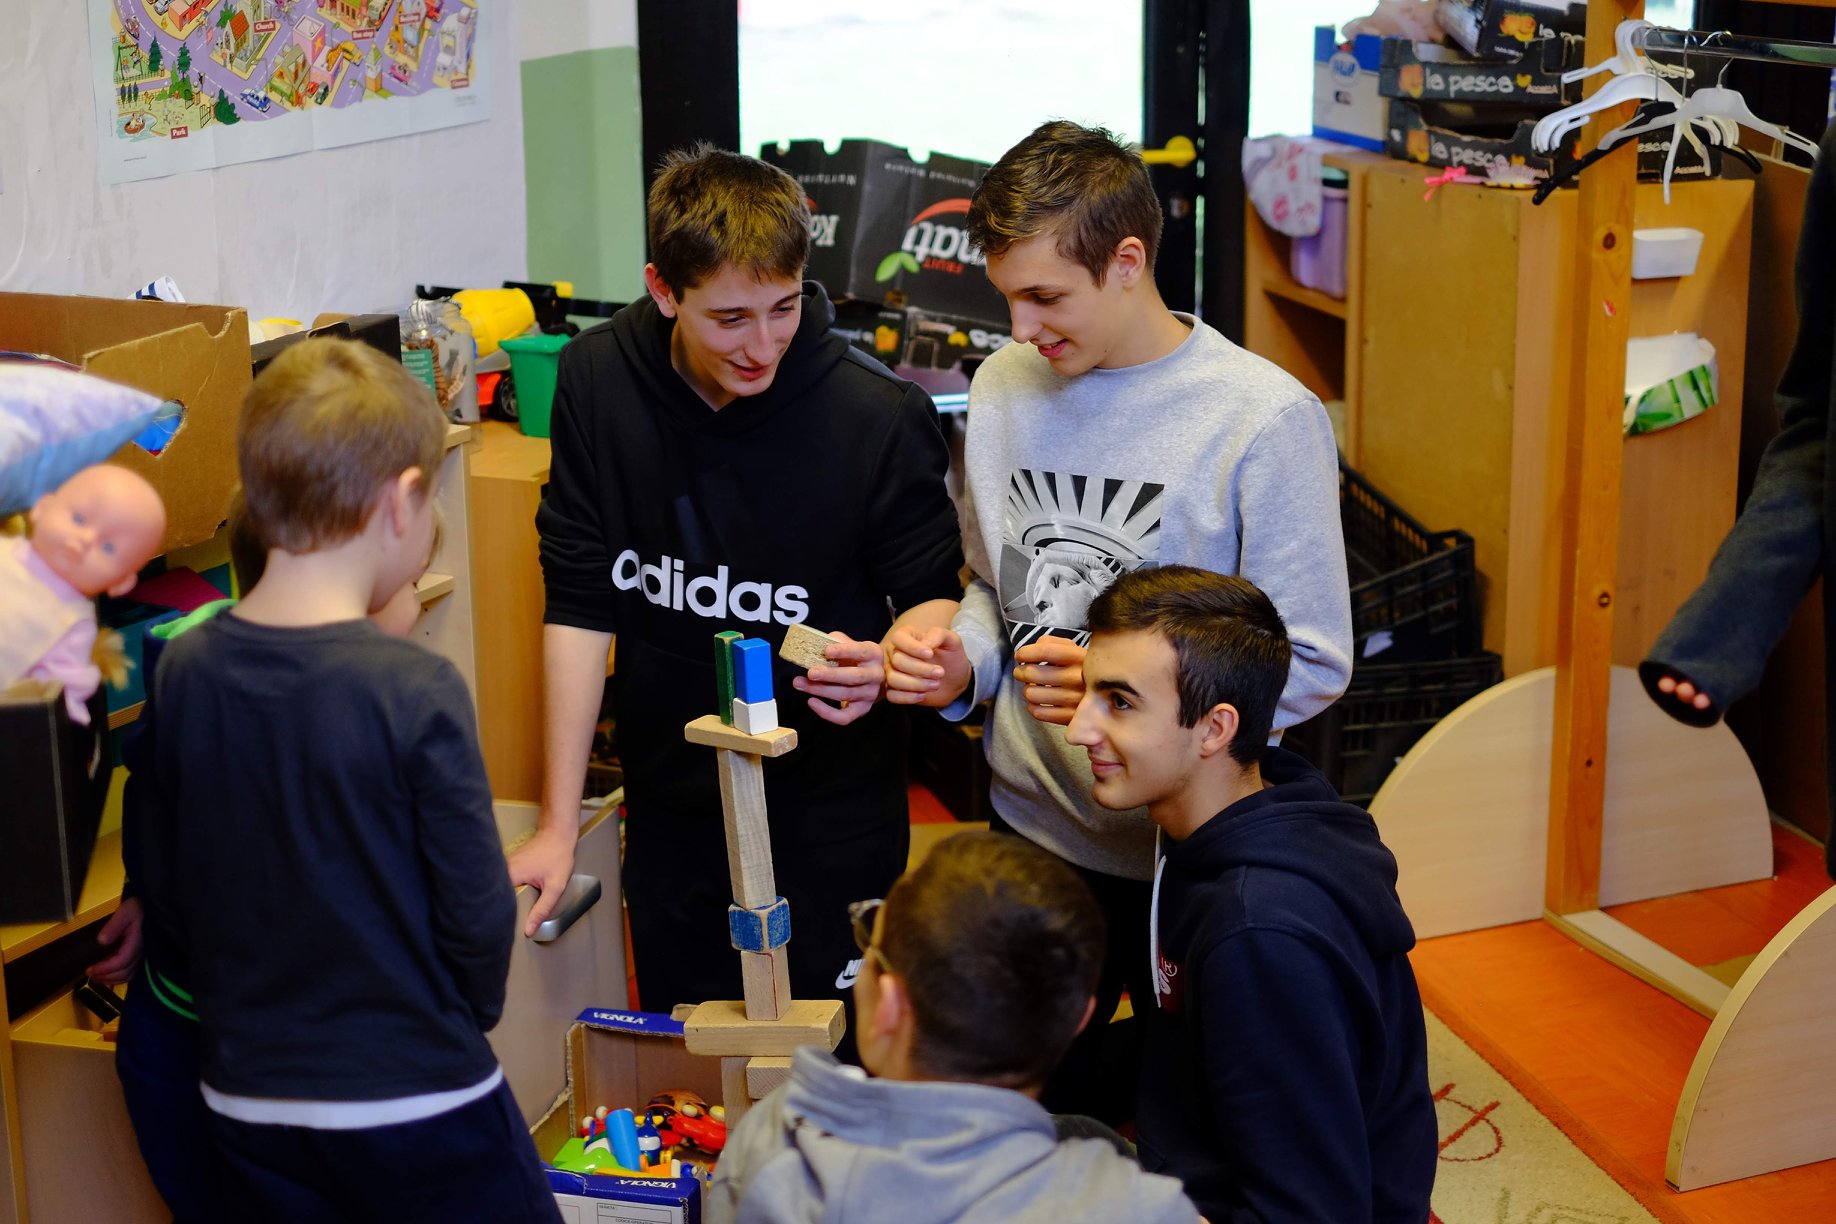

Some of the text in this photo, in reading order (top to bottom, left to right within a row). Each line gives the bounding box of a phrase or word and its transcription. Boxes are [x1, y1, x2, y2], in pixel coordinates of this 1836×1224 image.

[255, 21, 275, 31] Church
[1425, 68, 1445, 91] la
[1448, 75, 1514, 98] pesca
[172, 128, 186, 137] Park
[1430, 137, 1448, 160] la
[808, 214, 839, 246] Ko
[922, 256, 964, 274] FRUIT
[612, 549, 809, 626] adidas
[593, 1012, 644, 1025] VIGNOLA
[619, 1179, 677, 1189] VIGNOLA
